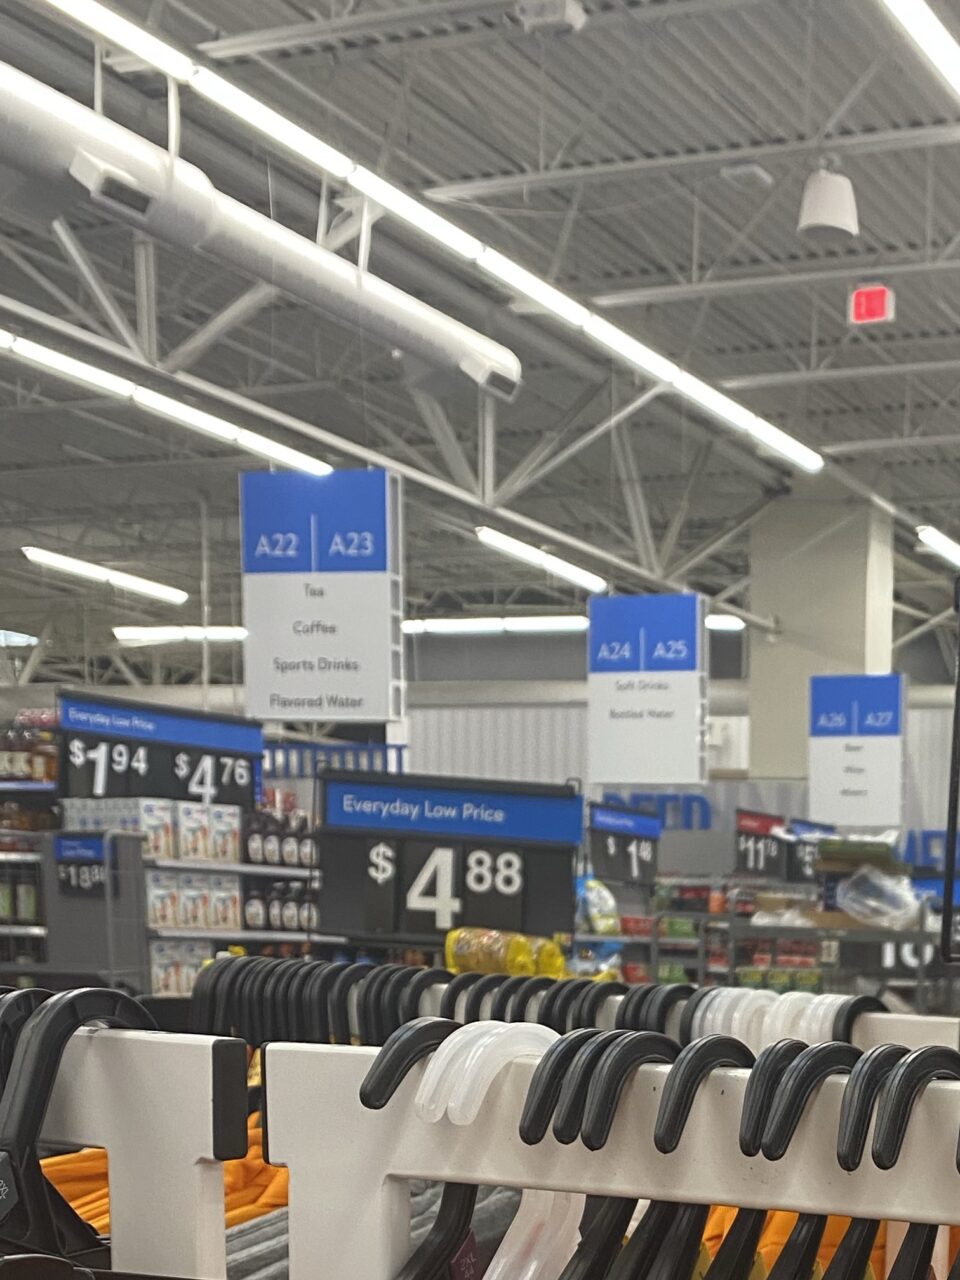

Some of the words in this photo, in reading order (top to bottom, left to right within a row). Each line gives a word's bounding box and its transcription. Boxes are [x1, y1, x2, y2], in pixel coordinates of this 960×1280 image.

[255, 532, 298, 557] A22
[328, 531, 374, 557] A23
[597, 641, 632, 659] A24
[653, 640, 688, 659] A25
[273, 657, 315, 672] Sports
[317, 657, 360, 671] Drinks
[326, 694, 364, 708] Water
[343, 794, 419, 821] Everyday
[424, 800, 458, 818] Low
[462, 803, 505, 822] Price
